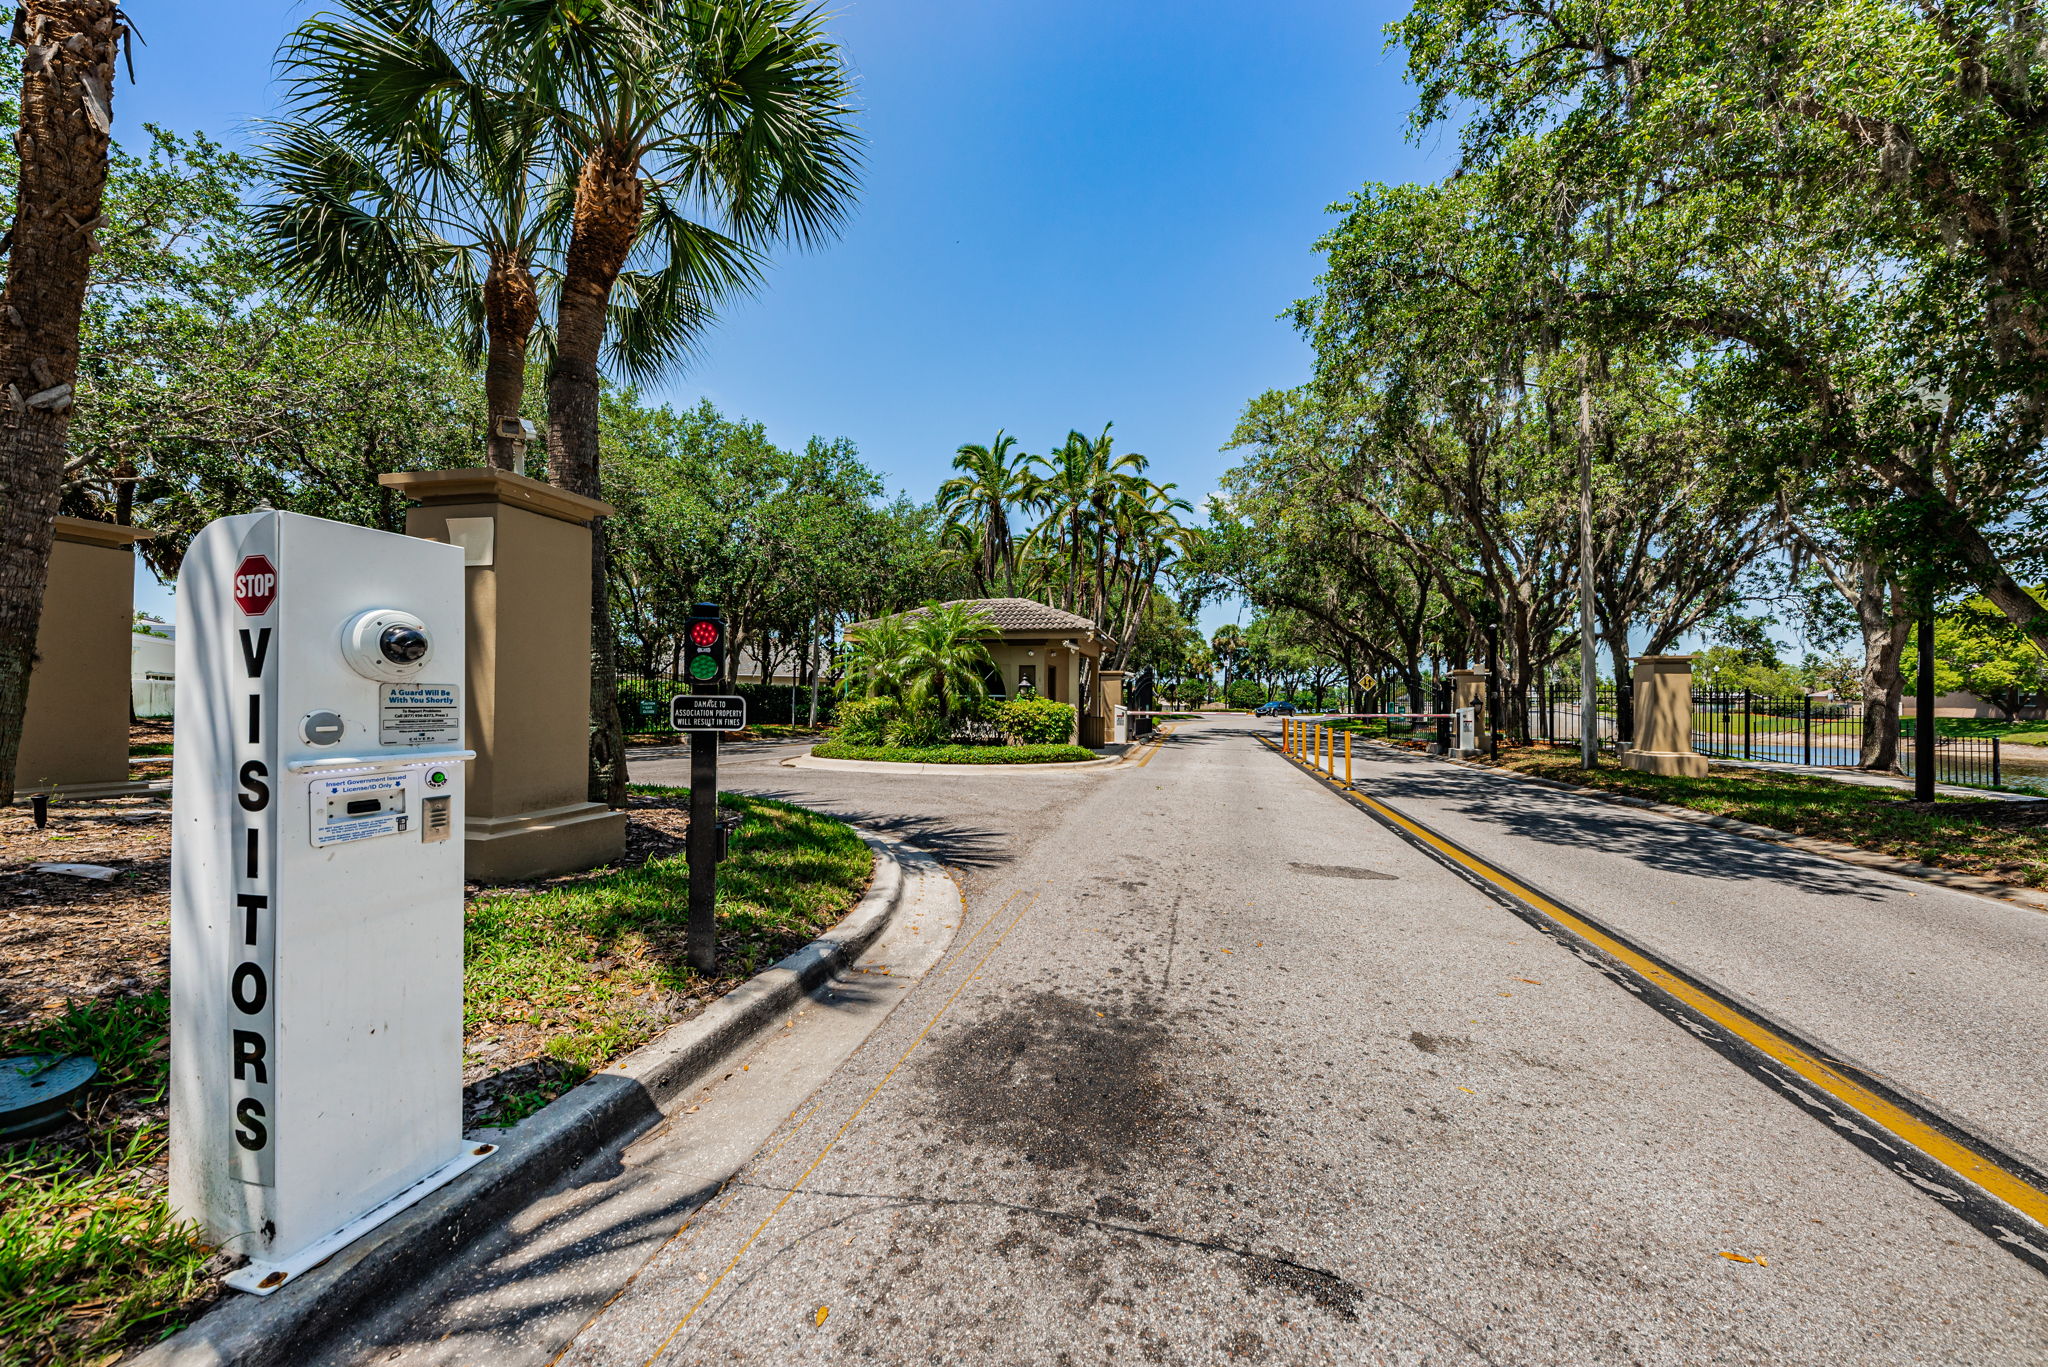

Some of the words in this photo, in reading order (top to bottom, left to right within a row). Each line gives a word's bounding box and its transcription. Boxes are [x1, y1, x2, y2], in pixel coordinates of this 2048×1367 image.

[236, 573, 275, 599] STOP
[426, 697, 453, 705] Shortly
[694, 700, 717, 708] DAMAGE
[719, 700, 726, 708] TO
[675, 709, 714, 717] ASSOCIATION
[715, 709, 743, 717] PROPERTY
[677, 718, 691, 726] WILL
[693, 718, 715, 726] RESULT
[716, 718, 723, 726] IN
[724, 718, 740, 726] FINES
[347, 777, 386, 785] Government
[342, 784, 377, 793] License/ID
[231, 627, 272, 1152] VISITORS
